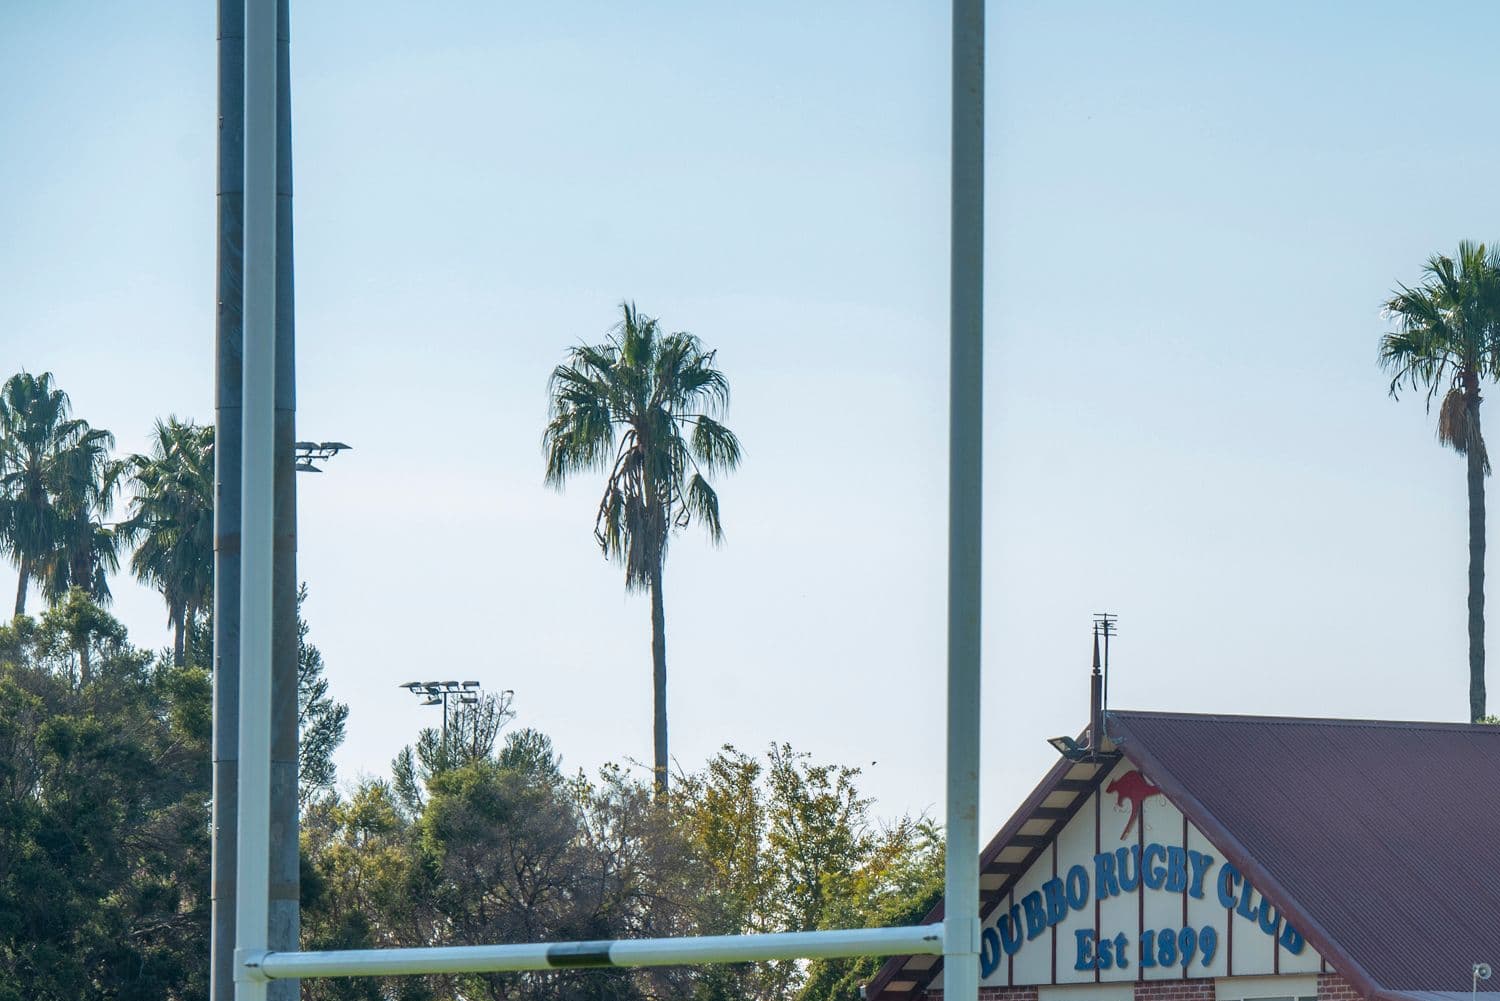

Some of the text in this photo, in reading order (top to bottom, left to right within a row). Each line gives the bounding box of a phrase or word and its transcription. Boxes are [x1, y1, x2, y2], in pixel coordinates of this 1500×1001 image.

[980, 864, 1090, 979] DUBBO
[1094, 843, 1214, 900] RUGBY
[1074, 924, 1217, 971] Est 1899
